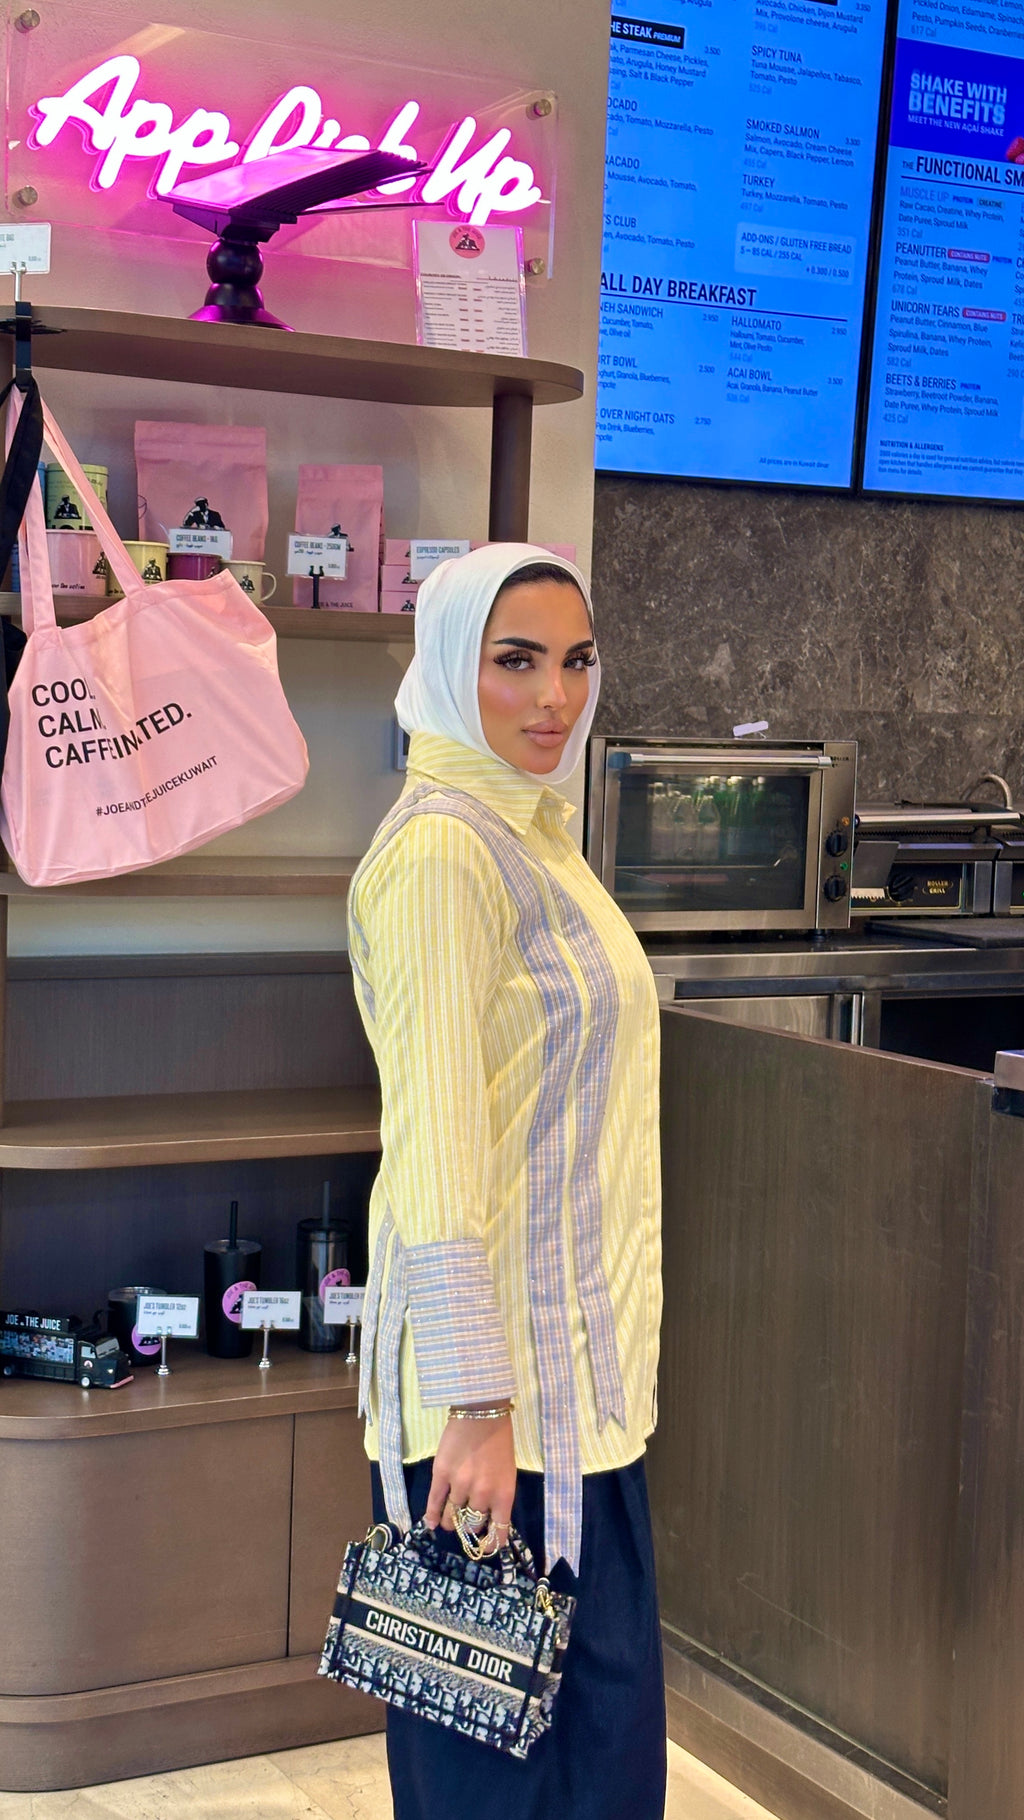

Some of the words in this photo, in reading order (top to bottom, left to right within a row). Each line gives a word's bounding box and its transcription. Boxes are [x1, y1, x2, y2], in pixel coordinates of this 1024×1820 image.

[771, 10, 804, 24] Provolone
[806, 18, 830, 30] cheese,
[832, 22, 857, 34] Arugula
[837, 12, 863, 24] Mustard
[623, 23, 652, 38] STEAK
[653, 32, 681, 43] PREMIUM
[620, 44, 654, 58] Parmesan
[656, 51, 682, 63] Cheese,
[684, 55, 708, 67] Pickles,
[752, 46, 777, 58] SPICY
[779, 49, 802, 64] TUNA
[626, 58, 653, 70] Arugula,
[656, 61, 676, 74] Honey
[678, 66, 706, 78] Mustard
[752, 60, 767, 69] Tuna
[769, 62, 796, 75] Mousse,
[834, 73, 862, 86] Tabasco,
[629, 69, 642, 78] Salt
[644, 72, 648, 80] &
[650, 72, 668, 82] Black
[670, 76, 694, 87] Pepper
[751, 71, 777, 83] Tomato,
[778, 75, 797, 86] Pesto
[910, 73, 964, 96] SHAKE
[966, 82, 1007, 104] WITH
[908, 90, 1006, 125] BENEFITS
[626, 115, 653, 126] Tomato,
[655, 120, 692, 132] Mozzarella,
[694, 125, 714, 135] Pesto
[746, 118, 782, 134] SMOKED
[784, 125, 820, 140] SALMON
[908, 114, 928, 124] MEET
[929, 117, 942, 128] THE
[944, 120, 962, 130] NEW
[980, 125, 1004, 137] SHAKE
[30, 54, 241, 200] App
[420, 116, 547, 226] Up
[745, 134, 772, 144] Salmon,
[806, 142, 827, 152] Cream
[828, 145, 852, 156] Cheese
[760, 146, 784, 158] Capers,
[786, 150, 804, 160] Black
[806, 153, 830, 165] Pepper,
[832, 157, 854, 167] Lemon
[903, 160, 913, 170] THE
[917, 156, 1001, 184] FUNCTIONAL
[608, 172, 636, 184] Mousse,
[638, 175, 669, 188] Avocado,
[670, 180, 697, 192] Tomato,
[742, 174, 775, 188] TURKEY
[742, 188, 762, 200] Turkey,
[765, 192, 802, 204] Mozzarella,
[803, 196, 828, 208] Tomato,
[830, 200, 848, 210] Pesto
[900, 186, 935, 201] MUSCLE
[937, 192, 949, 202] UP
[614, 215, 636, 228] CLUB
[615, 232, 646, 244] Avocado,
[648, 235, 674, 246] Tomato,
[676, 238, 694, 249] Pesto
[741, 232, 774, 244] ADD-ONS
[780, 237, 808, 249] GLUTEN
[810, 240, 826, 250] FREE
[828, 242, 852, 254] BREAD
[896, 242, 947, 258] PEANUTTER
[895, 256, 918, 267] Peanut
[920, 260, 941, 270] Butter,
[942, 262, 968, 273] Banana,
[970, 266, 987, 276] Whey
[600, 272, 627, 292] ALL
[632, 275, 663, 296] DAY
[668, 280, 757, 306] BREAKFAST
[920, 274, 944, 285] Sproud
[947, 277, 962, 288] Milk,
[964, 279, 982, 288] Dates
[617, 304, 664, 319] SANDWICH
[892, 300, 930, 315] UNICORN
[932, 304, 960, 318] TEARS
[731, 316, 782, 332] HALLOMATO
[890, 314, 913, 324] Peanut
[915, 317, 936, 328] Butter,
[938, 320, 972, 332] Cinnamon,
[974, 323, 988, 332] Blue
[889, 328, 918, 340] Spirulina,
[921, 332, 946, 343] Banana,
[948, 335, 966, 346] Whey
[888, 342, 911, 353] Sproud
[913, 345, 928, 356] Milk,
[930, 347, 948, 357] Dates
[613, 356, 638, 368] BOWL
[728, 368, 748, 379] ACAI
[749, 368, 772, 382] BOWL
[886, 373, 912, 386] BEETS
[914, 376, 920, 387] &
[922, 376, 956, 390] BERRIES
[922, 390, 947, 400] Beetroot
[600, 408, 622, 420] OVER
[625, 410, 651, 422] NIGHT
[653, 412, 675, 424] OATS
[880, 440, 908, 448] NUTRITION
[915, 443, 944, 452] ALLERGENS
[416, 546, 438, 554] ESPRESSO
[439, 546, 460, 554] CAPSULES
[6, 1314, 18, 1326] JOE
[25, 1316, 39, 1328] THE
[40, 1318, 61, 1331] JUICE
[366, 1610, 459, 1662] CHRISTIAN
[468, 1650, 513, 1684] DIOR
